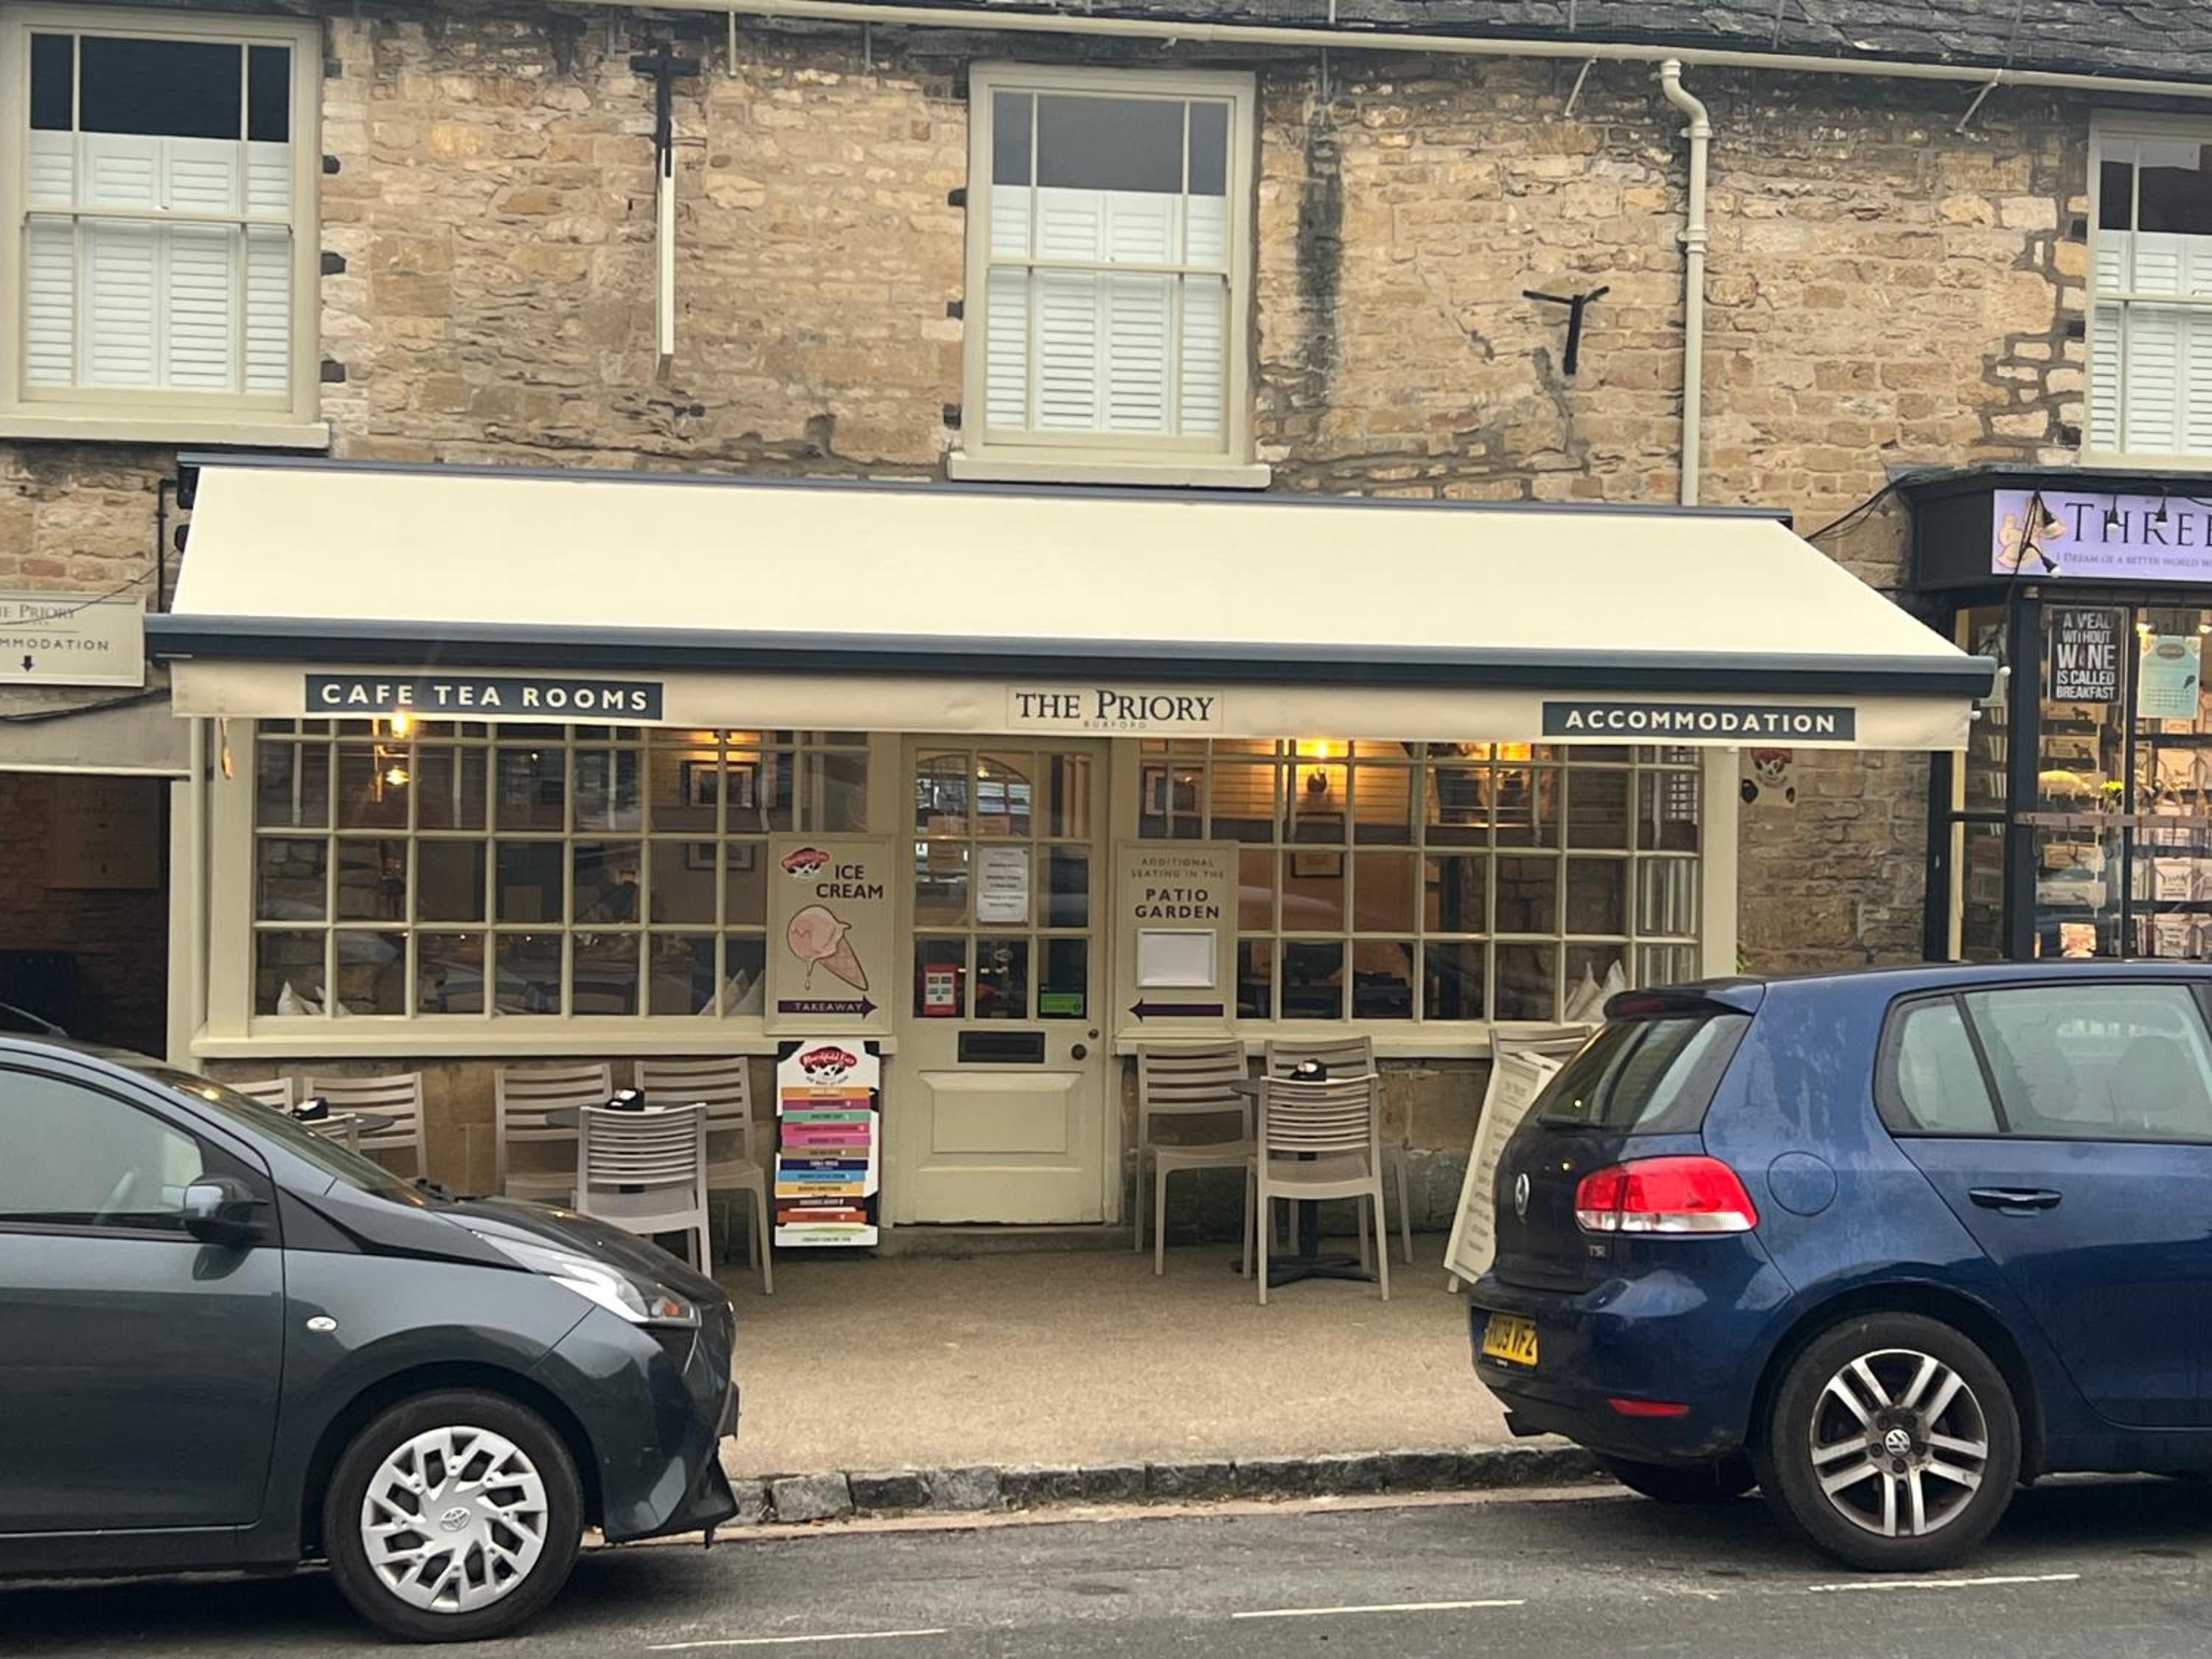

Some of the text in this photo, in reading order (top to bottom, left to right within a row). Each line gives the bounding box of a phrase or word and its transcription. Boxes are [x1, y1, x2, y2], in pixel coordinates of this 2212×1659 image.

[2126, 557, 2159, 566] BETTER
[2162, 558, 2199, 568] WORLD
[2063, 613, 2072, 627] A
[2062, 629, 2112, 644] WITHOUT
[2057, 670, 2115, 685] IS CALLED
[321, 684, 647, 710] CAFE TEA ROOMS
[2056, 686, 2115, 699] BREAKFAST
[1015, 689, 1214, 721] THE PRIORY
[1084, 720, 1147, 729] BURFORD
[1565, 710, 1834, 732] ACCOMMODATION
[1141, 858, 1214, 867] ADDITIONAL
[835, 864, 864, 880] ICE
[1132, 869, 1224, 879] SEATING IN THE
[816, 883, 883, 899] CREAM
[1146, 888, 1208, 902] PATIO
[1135, 905, 1219, 919] GARDEN
[794, 1001, 863, 1012] TAKEAWAY
